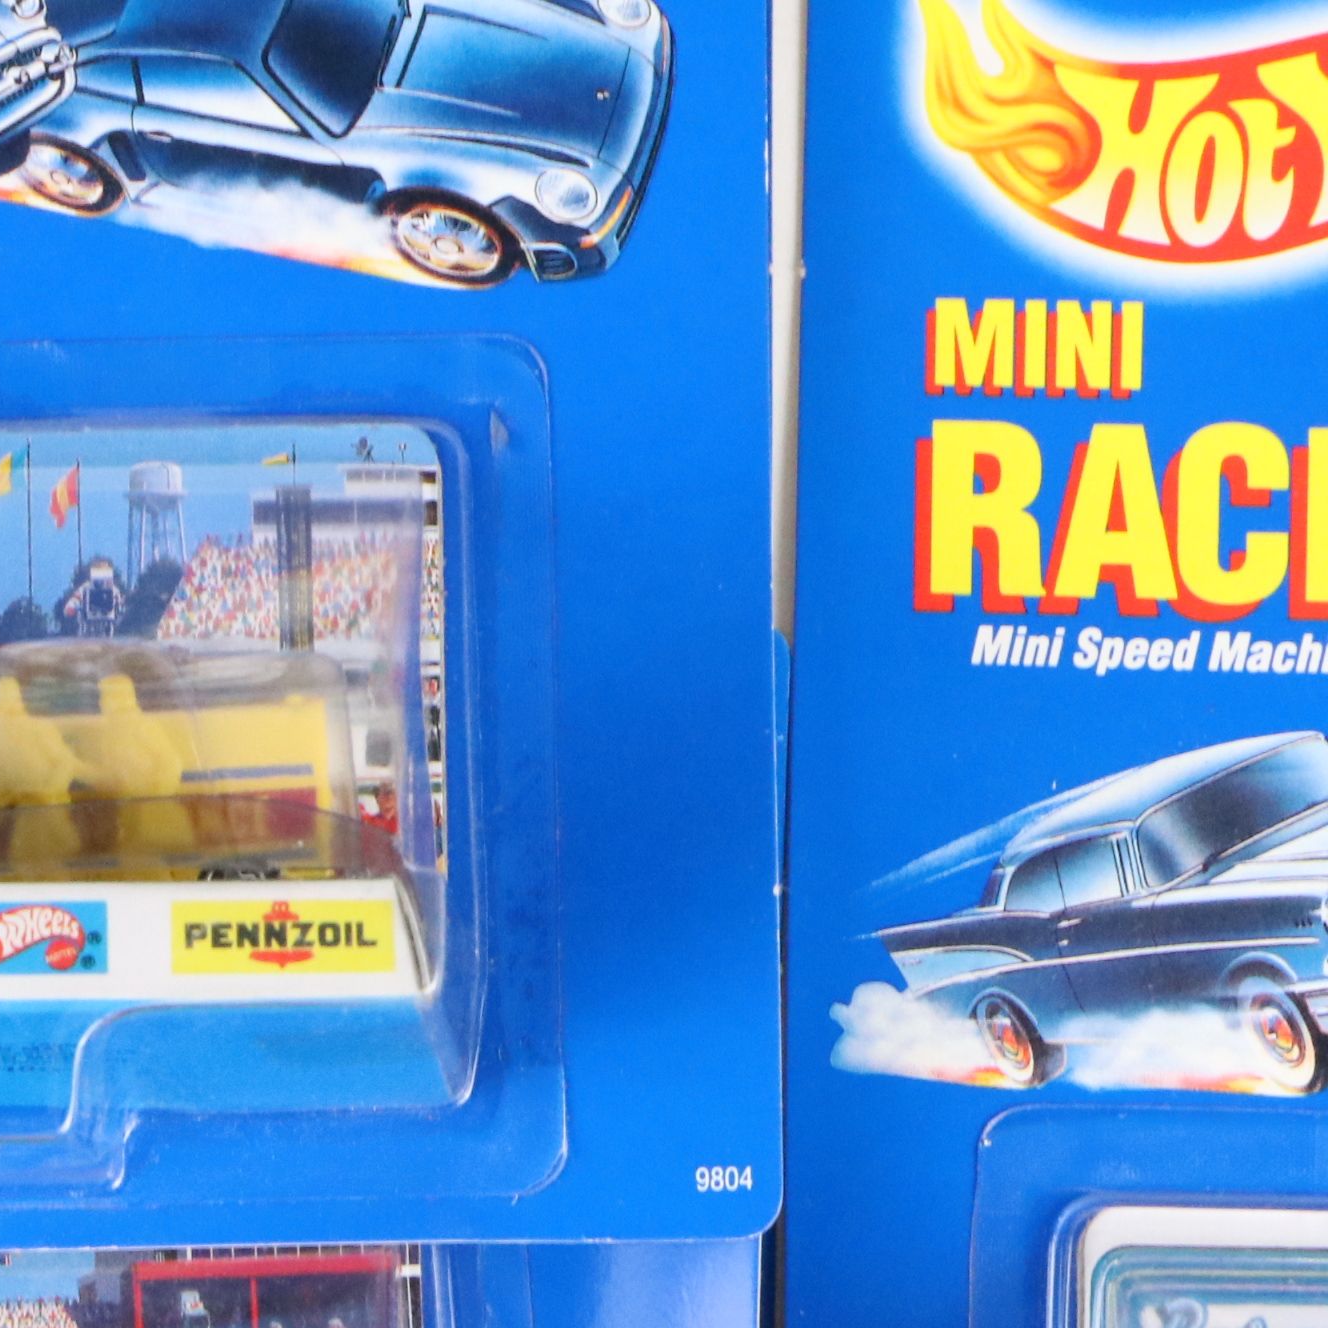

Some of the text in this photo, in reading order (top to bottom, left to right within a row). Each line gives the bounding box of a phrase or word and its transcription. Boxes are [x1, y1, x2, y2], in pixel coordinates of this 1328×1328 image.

[925, 297, 1144, 399] MINI
[971, 625, 1328, 677] Mini Speed Mach
[184, 921, 378, 949] PENNZOIL
[695, 1166, 752, 1192] 9804
